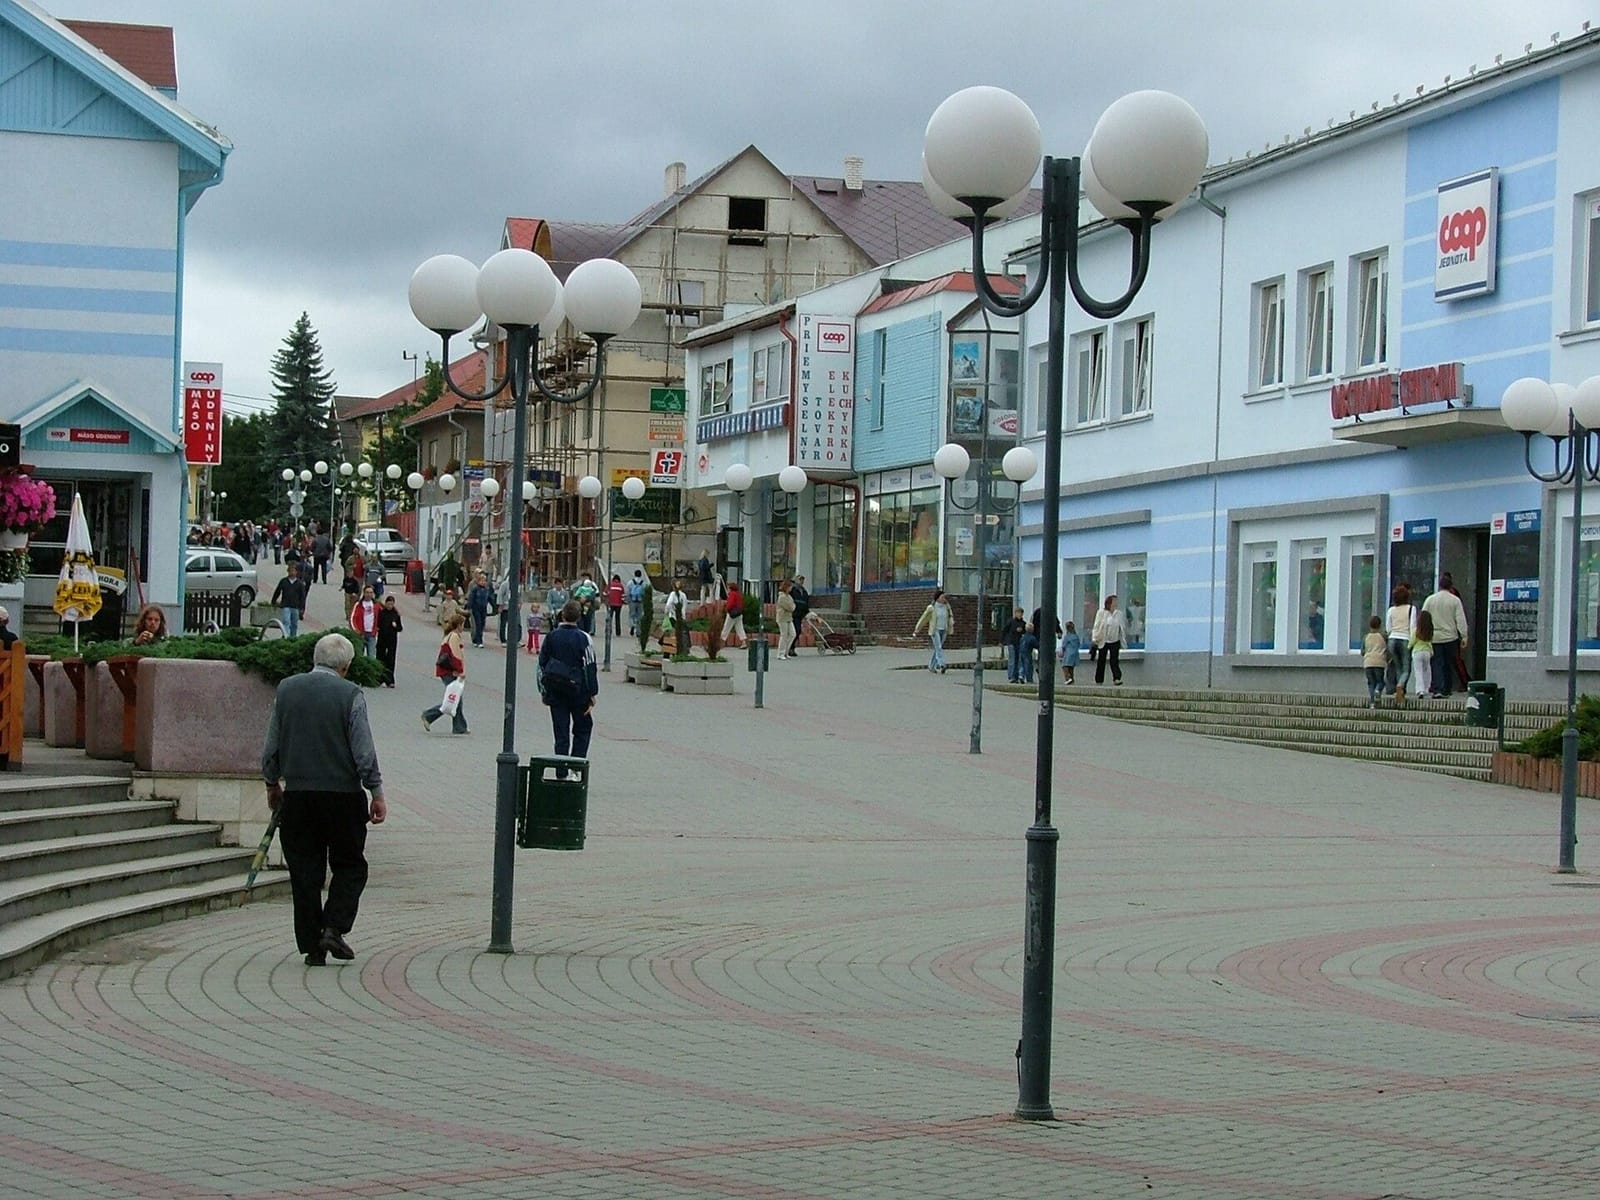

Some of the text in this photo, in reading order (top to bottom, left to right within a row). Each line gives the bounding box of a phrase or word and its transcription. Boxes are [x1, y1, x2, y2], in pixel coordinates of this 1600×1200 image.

[1439, 253, 1468, 269] JEDNOTA
[1440, 206, 1486, 261] coop
[823, 333, 845, 343] coop
[191, 372, 215, 384] coop
[813, 397, 822, 460] TOVAR
[826, 371, 836, 460] ELEKTRO
[839, 371, 852, 461] KUCHYNKA
